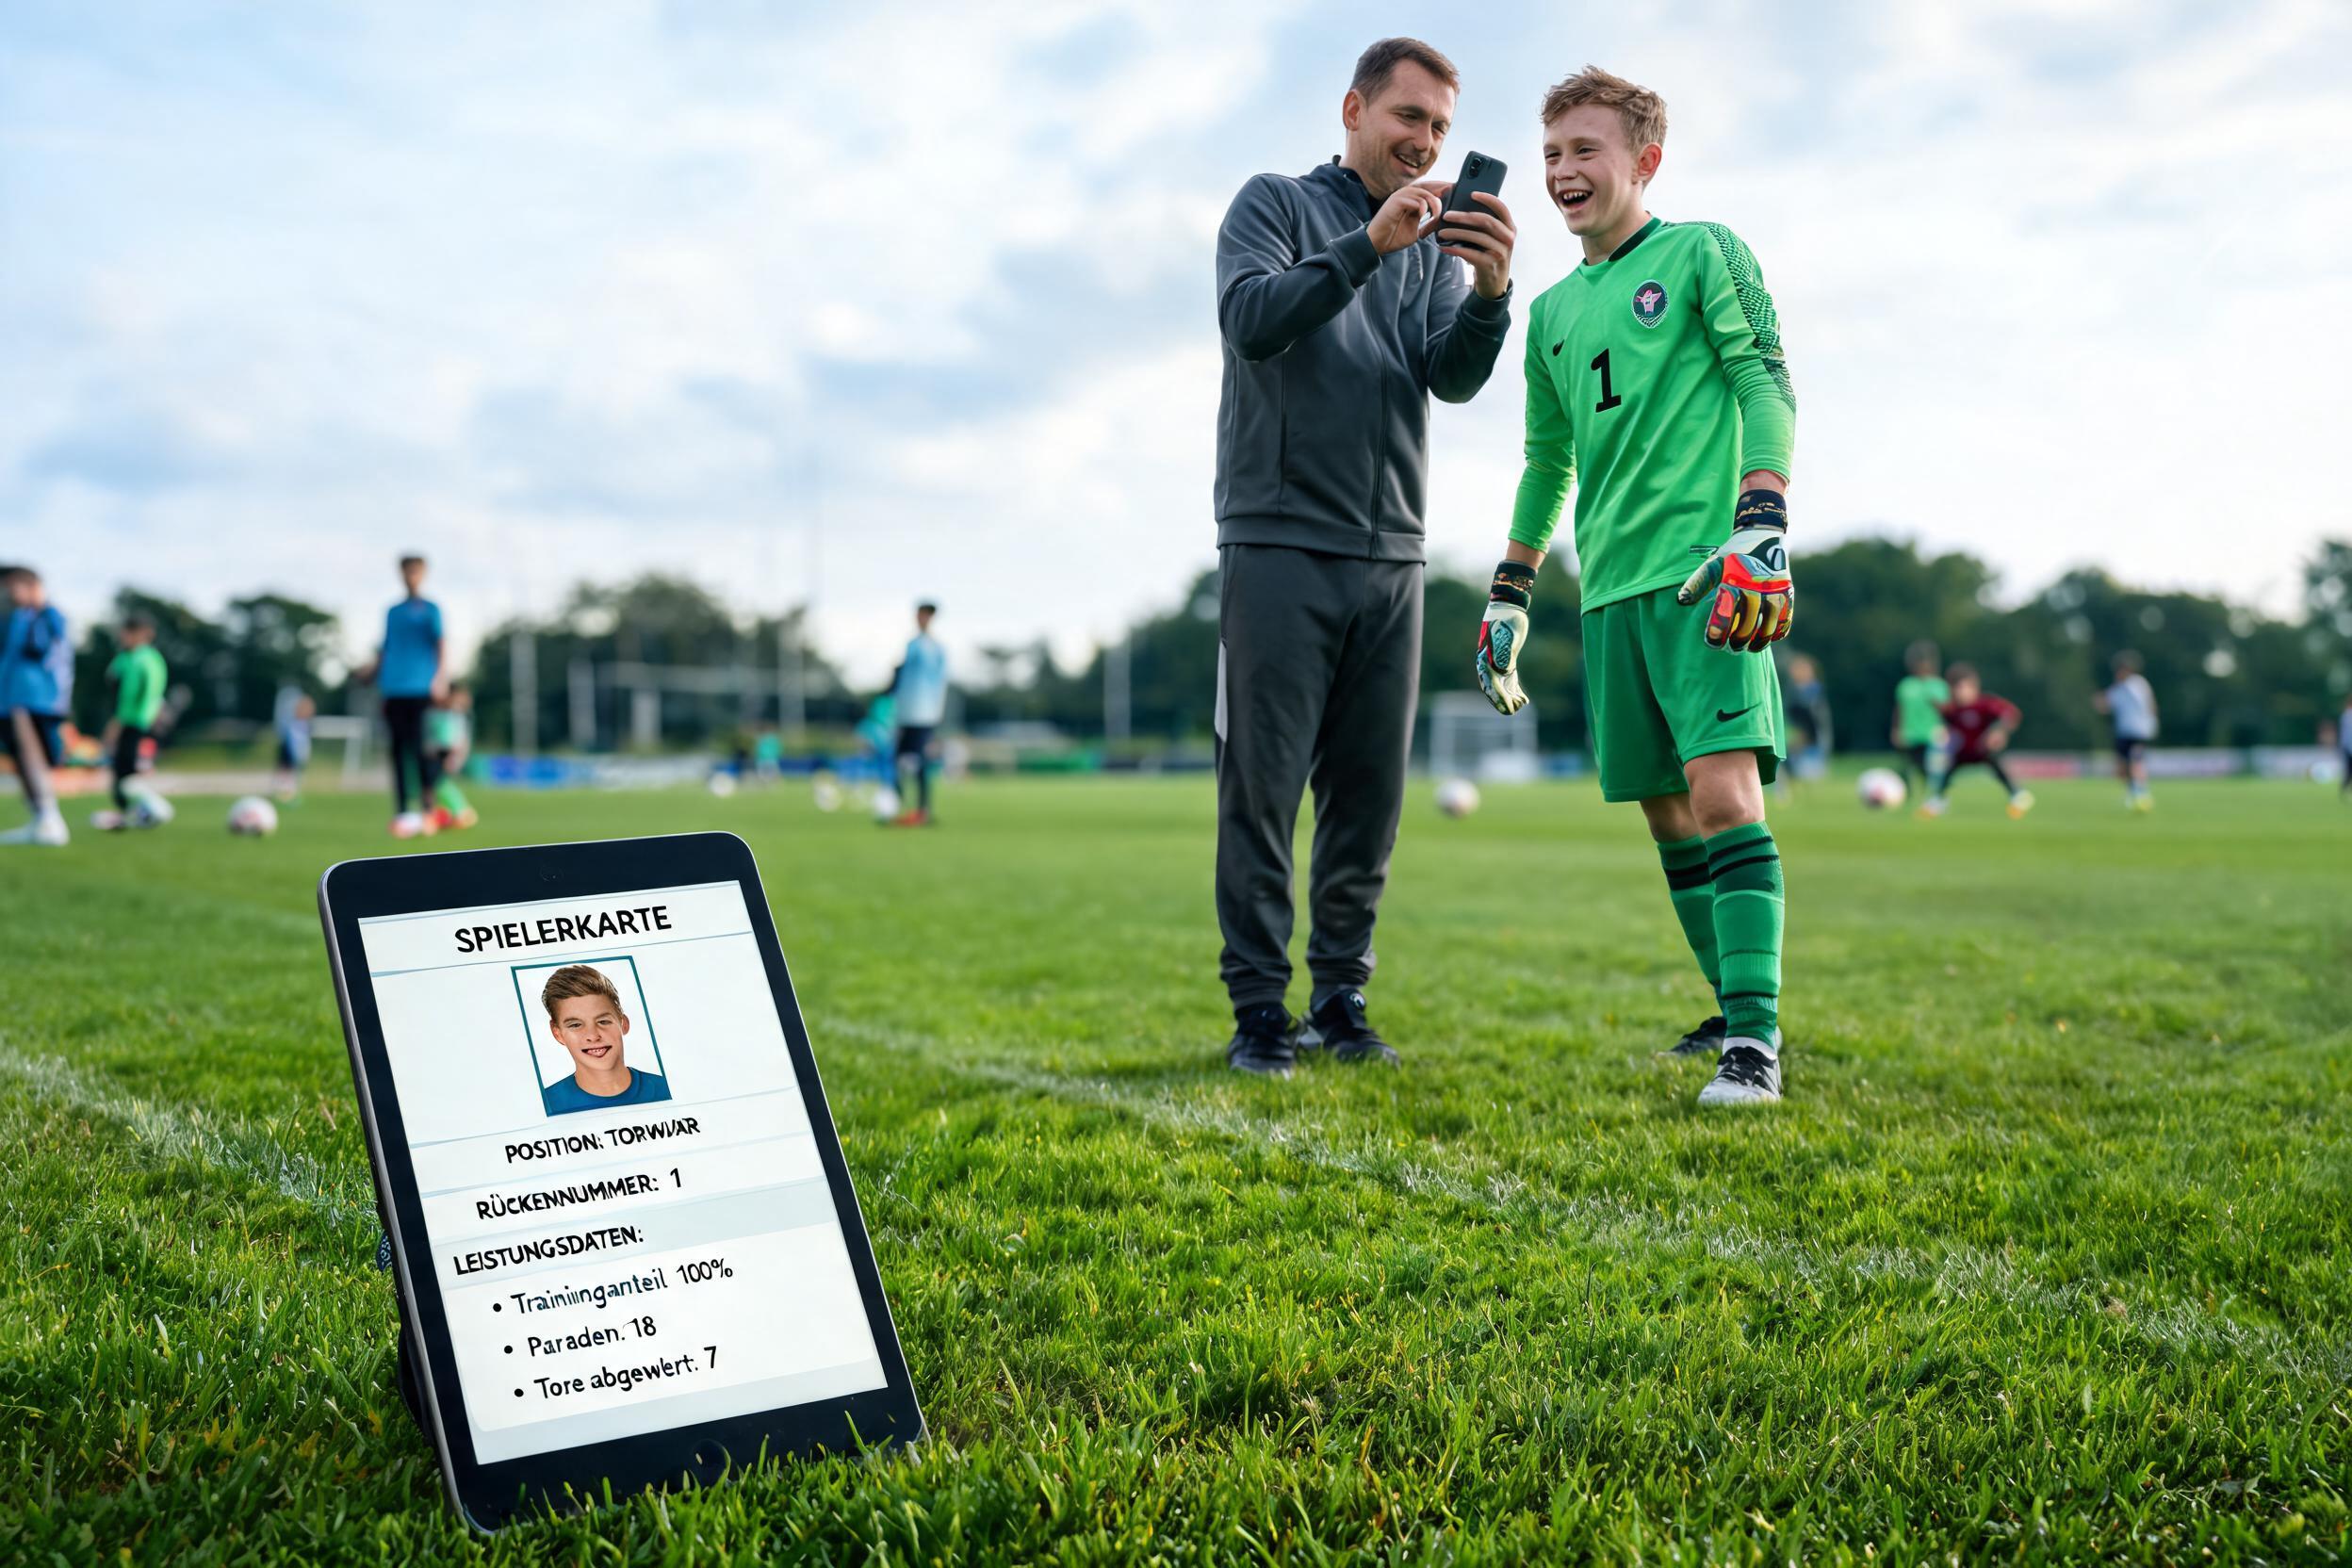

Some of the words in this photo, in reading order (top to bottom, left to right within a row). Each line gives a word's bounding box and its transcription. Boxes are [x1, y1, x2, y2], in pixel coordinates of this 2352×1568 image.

[1591, 348, 1622, 413] 1
[454, 905, 673, 954] SPIELERKARTE
[504, 1133, 604, 1164] POSITION:
[476, 1174, 659, 1220] RÜCKENNUMMER:
[670, 1168, 682, 1188] 1
[452, 1225, 645, 1276] LEISTUNGSDATEN:
[676, 1257, 734, 1284] 100%
[629, 1315, 657, 1338] 18
[533, 1376, 585, 1399] Tore
[704, 1346, 717, 1369] 7
